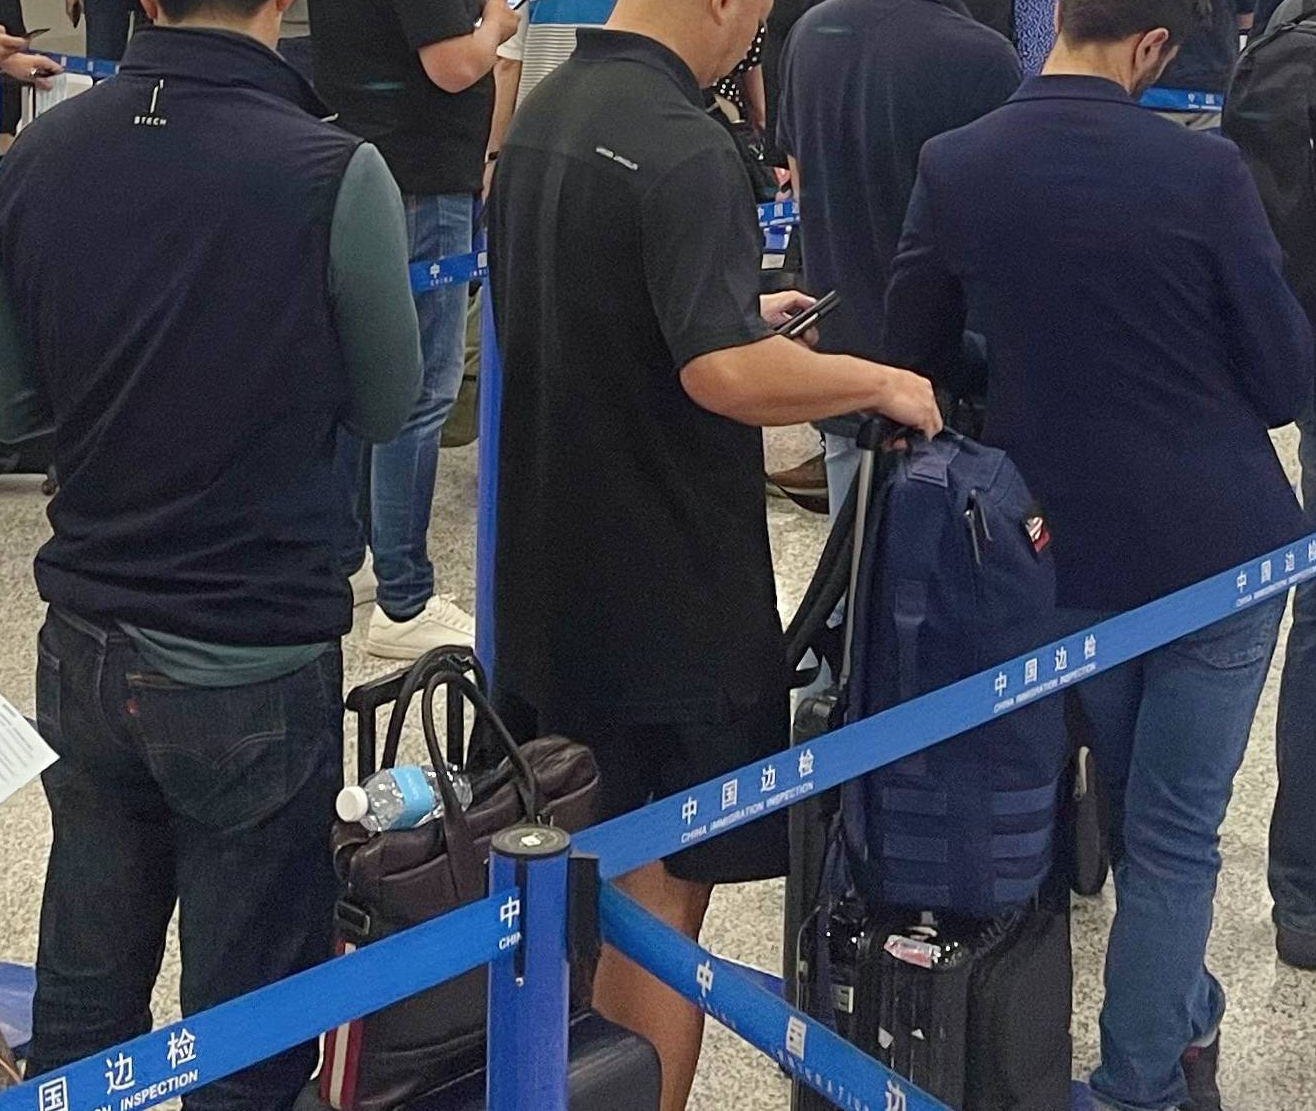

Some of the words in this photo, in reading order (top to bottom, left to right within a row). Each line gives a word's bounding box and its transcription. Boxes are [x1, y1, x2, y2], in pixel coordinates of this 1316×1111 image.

[681, 748, 815, 826] 中国边检
[499, 895, 521, 929] 中
[119, 1068, 199, 1111] INSPECTION
